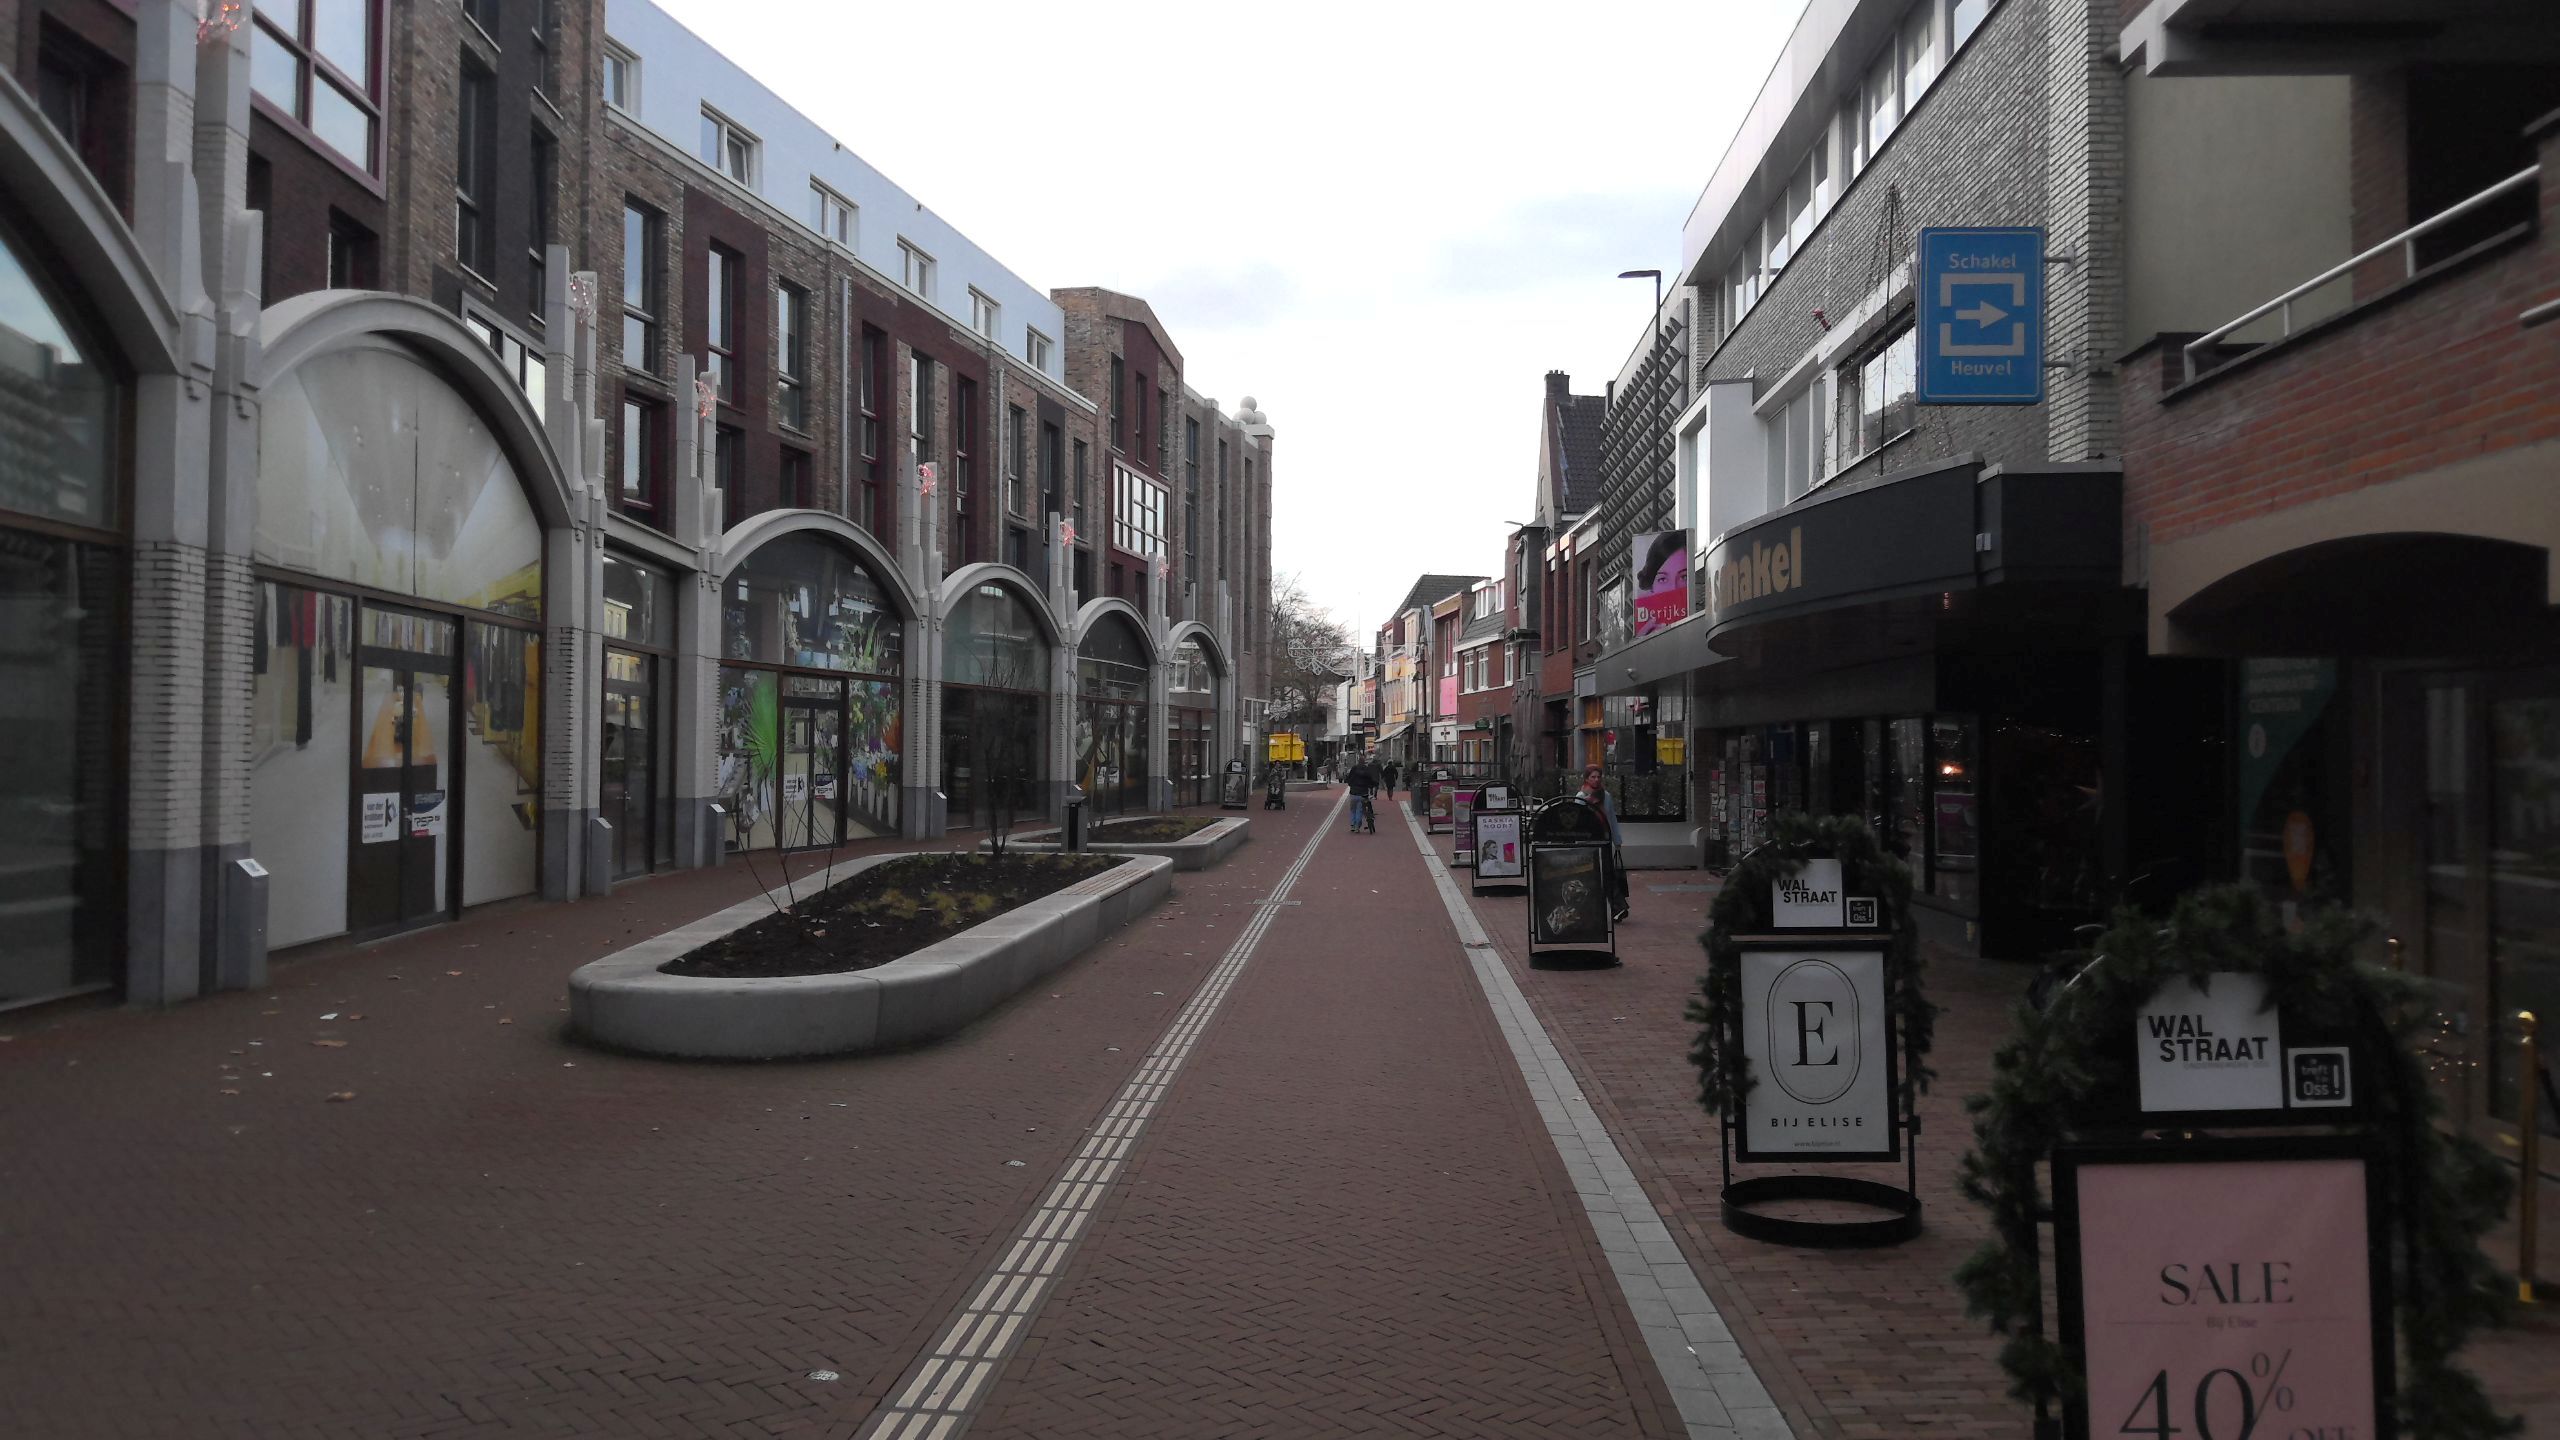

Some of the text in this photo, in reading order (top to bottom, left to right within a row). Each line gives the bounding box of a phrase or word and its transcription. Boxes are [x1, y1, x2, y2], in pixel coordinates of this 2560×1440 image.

[1948, 253, 2017, 269] Schakel
[1951, 359, 2011, 376] Heuvel
[1637, 605, 1686, 622] derijks
[1778, 879, 1810, 892] WAL
[1783, 890, 1837, 904] STRAAT
[1789, 1001, 1839, 1066] E
[2147, 1014, 2213, 1038] WAL
[2159, 1037, 2269, 1062] STRAAT
[2303, 1081, 2329, 1096] Oss
[1771, 1117, 1863, 1127] BIJ ELISE
[2160, 1261, 2294, 1306] SALE
